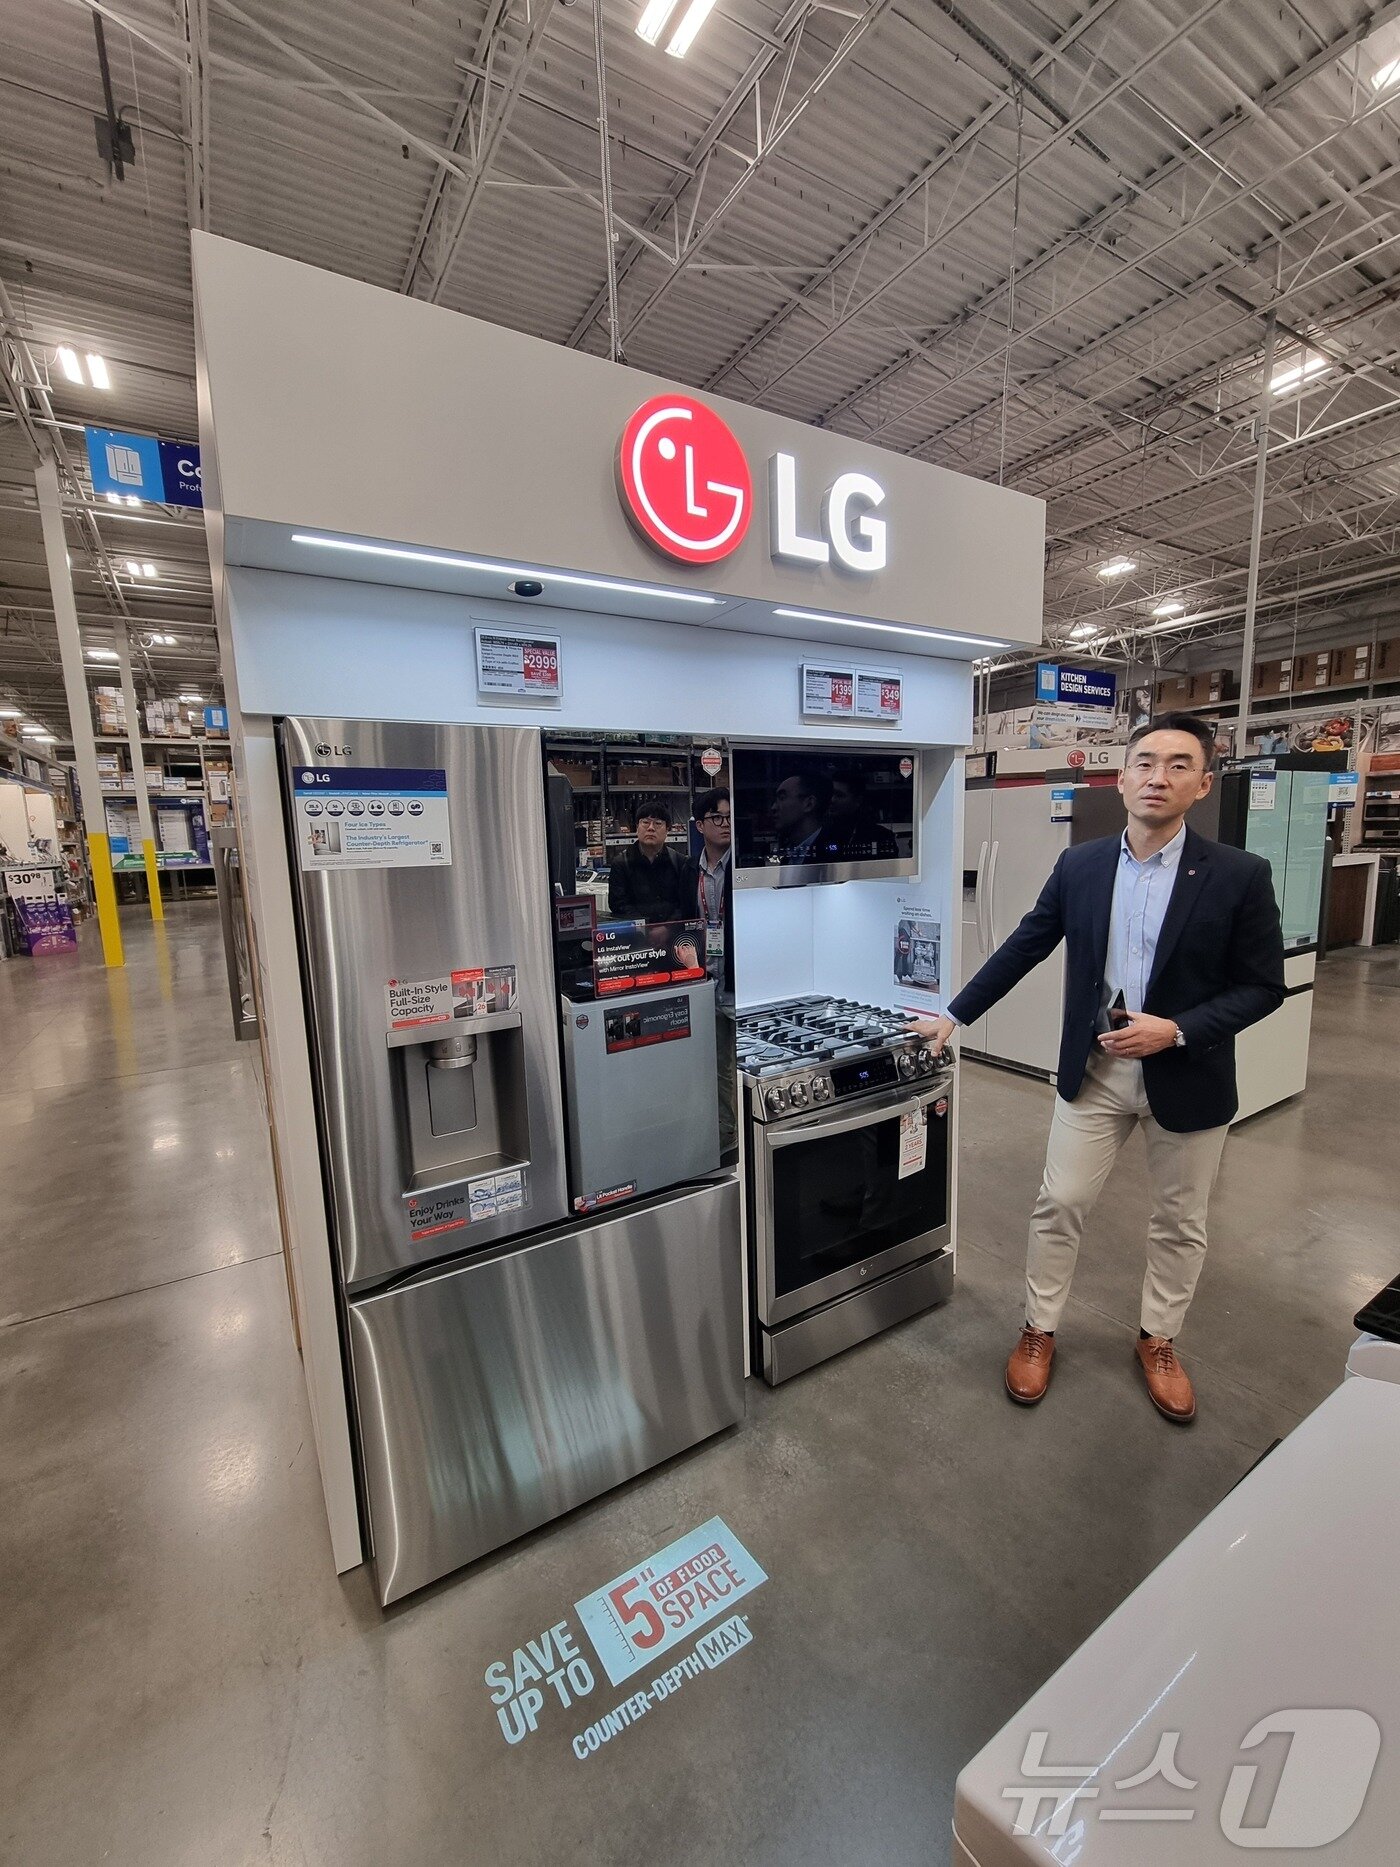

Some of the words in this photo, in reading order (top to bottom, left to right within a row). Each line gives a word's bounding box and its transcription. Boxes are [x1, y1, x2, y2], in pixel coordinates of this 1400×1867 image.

[768, 452, 887, 572] LG
[524, 655, 557, 670] $2999
[1060, 672, 1087, 684] KITCHEN
[832, 684, 852, 695] $1399
[881, 689, 900, 700] $349
[1060, 682, 1083, 693] DESIGN
[1083, 685, 1111, 697] SERVICES
[334, 745, 352, 756] LG
[1089, 751, 1109, 764] LG
[316, 773, 331, 782] LG
[368, 821, 386, 829] Types
[357, 834, 387, 842] Industry's
[387, 834, 410, 842] Largest
[605, 932, 616, 940] LG
[616, 954, 631, 963] out
[631, 952, 648, 963] your
[648, 949, 667, 960] style
[599, 966, 610, 974] with
[610, 965, 624, 973] Mirror
[389, 986, 424, 998] Built-In
[424, 983, 448, 995] Style
[390, 996, 431, 1007] Full-Size
[391, 1004, 435, 1017] Capacity
[409, 1206, 434, 1218] Enjoy
[435, 1196, 465, 1210] Drinks
[410, 1216, 433, 1228] Your
[433, 1210, 455, 1223] Way
[655, 1575, 677, 1597] OF
[677, 1547, 722, 1585] FLOOR
[660, 1559, 747, 1629] SPACE
[484, 1620, 580, 1706] SAVE
[496, 1687, 545, 1746] UP
[546, 1657, 596, 1709] TO
[571, 1656, 706, 1761] COUNTER-DEPTH
